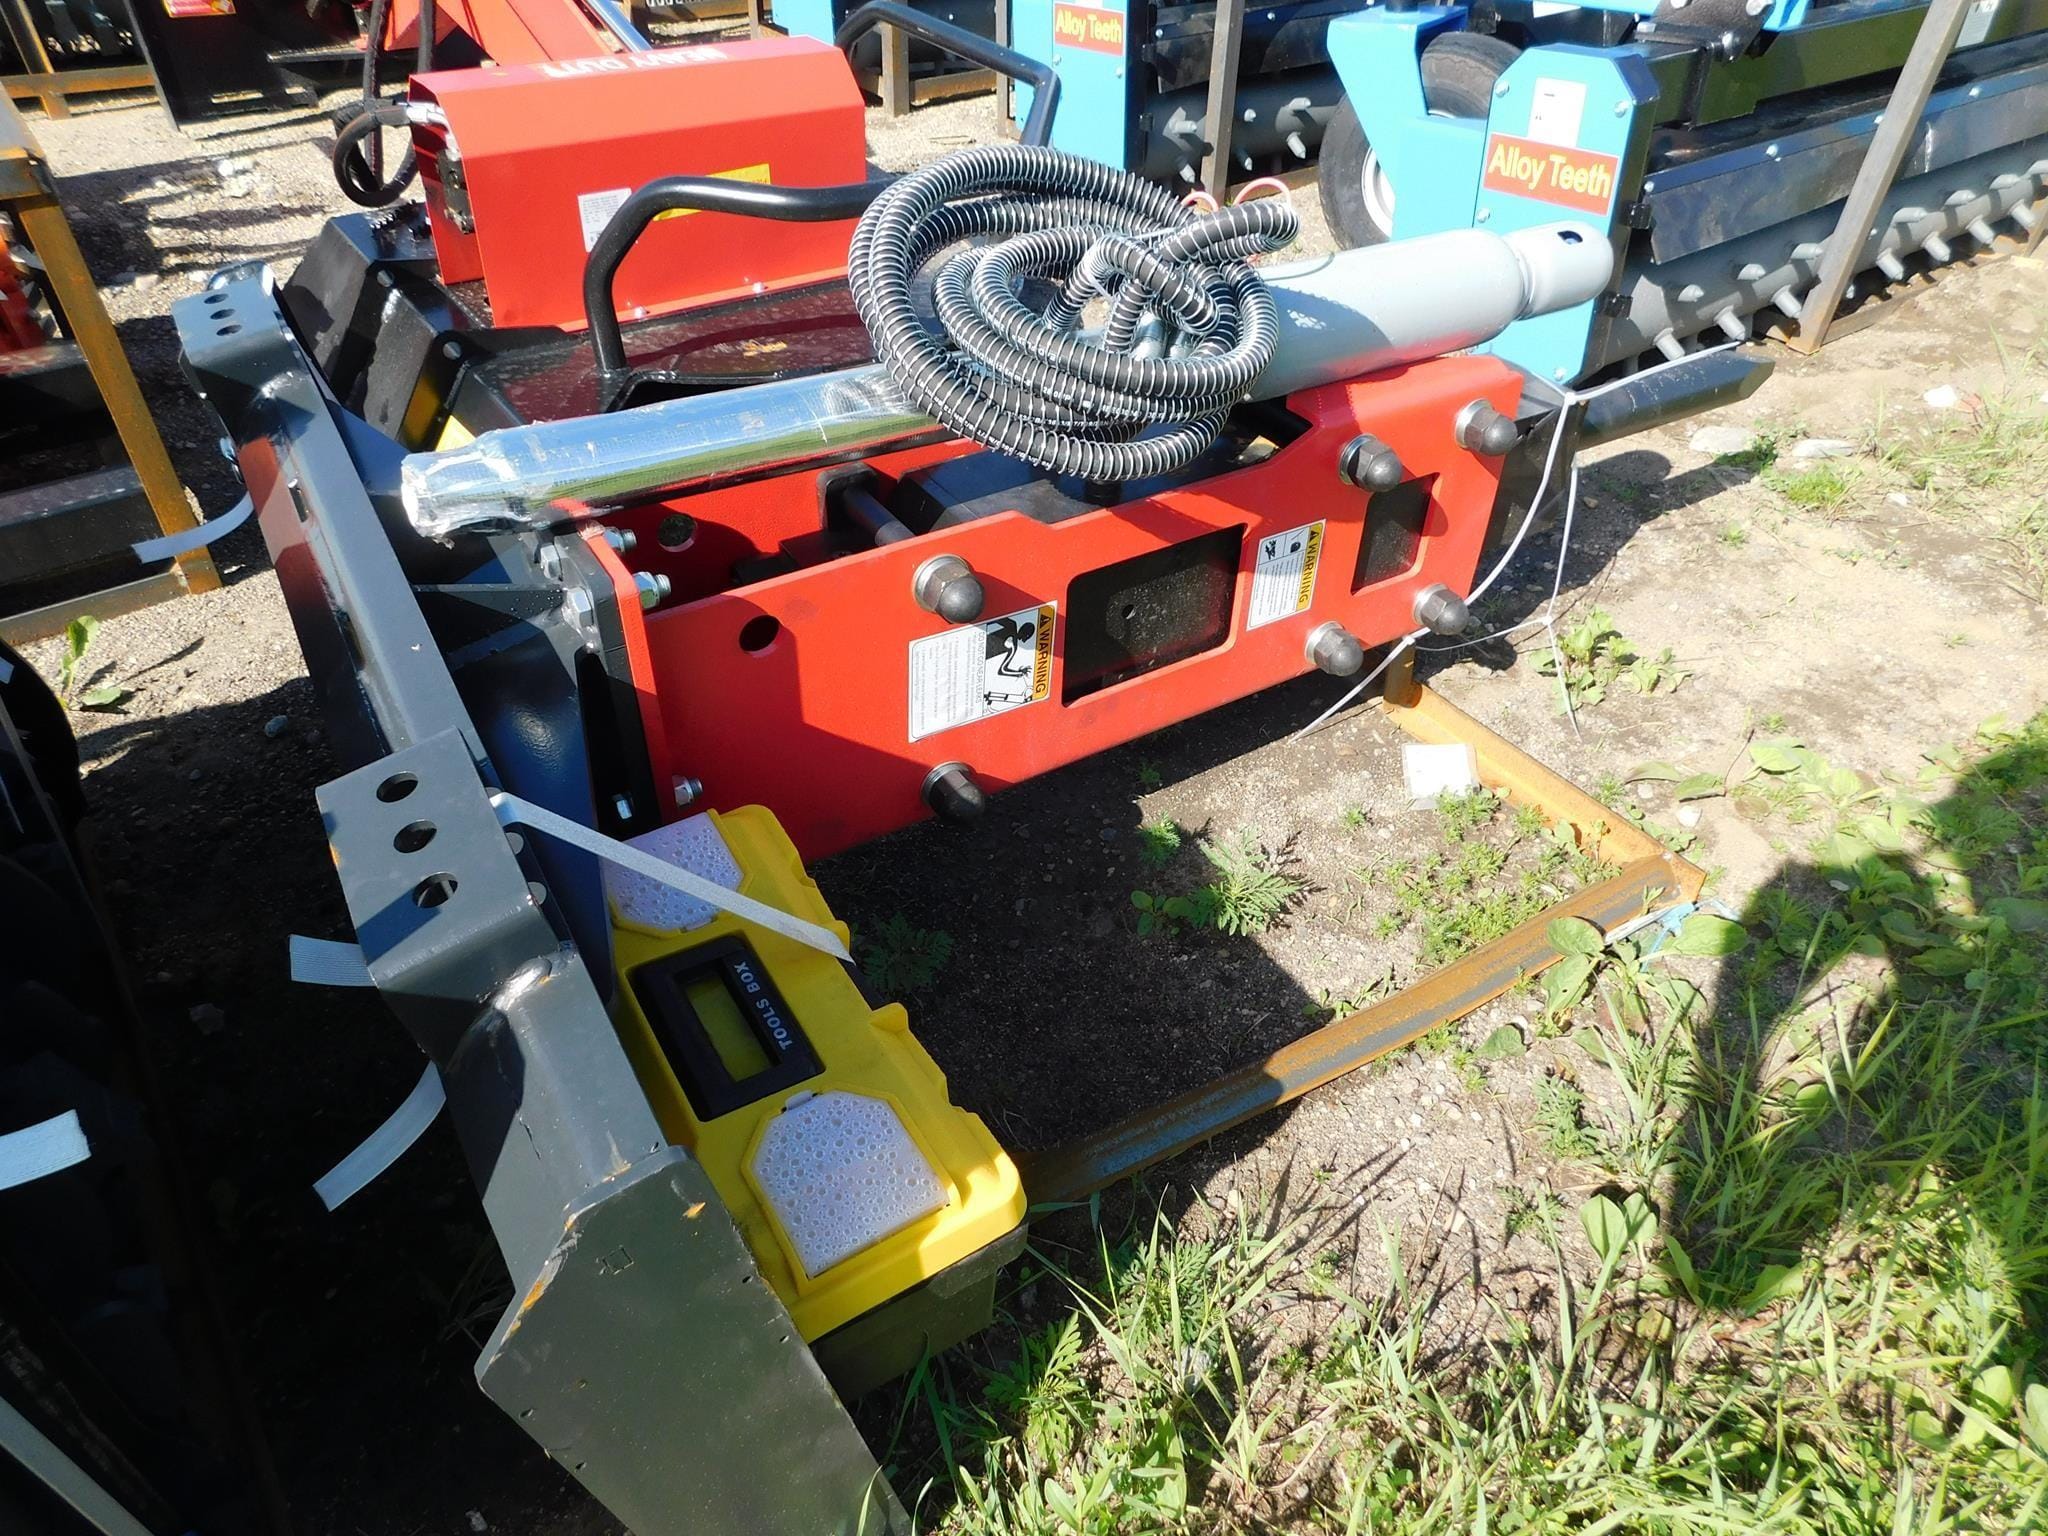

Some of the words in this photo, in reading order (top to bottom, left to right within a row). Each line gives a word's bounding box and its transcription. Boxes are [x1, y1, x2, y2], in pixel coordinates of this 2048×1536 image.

[1055, 8, 1087, 42] Alloy
[1087, 12, 1122, 44] Teeth
[542, 57, 628, 79] DUTY
[1487, 143, 1546, 191] Alloy
[1549, 153, 1612, 199] Teeth
[1298, 542, 1318, 603] WARNING
[1035, 629, 1051, 694] WARNING
[734, 961, 760, 993] BOX
[756, 998, 793, 1051] TOOLS
